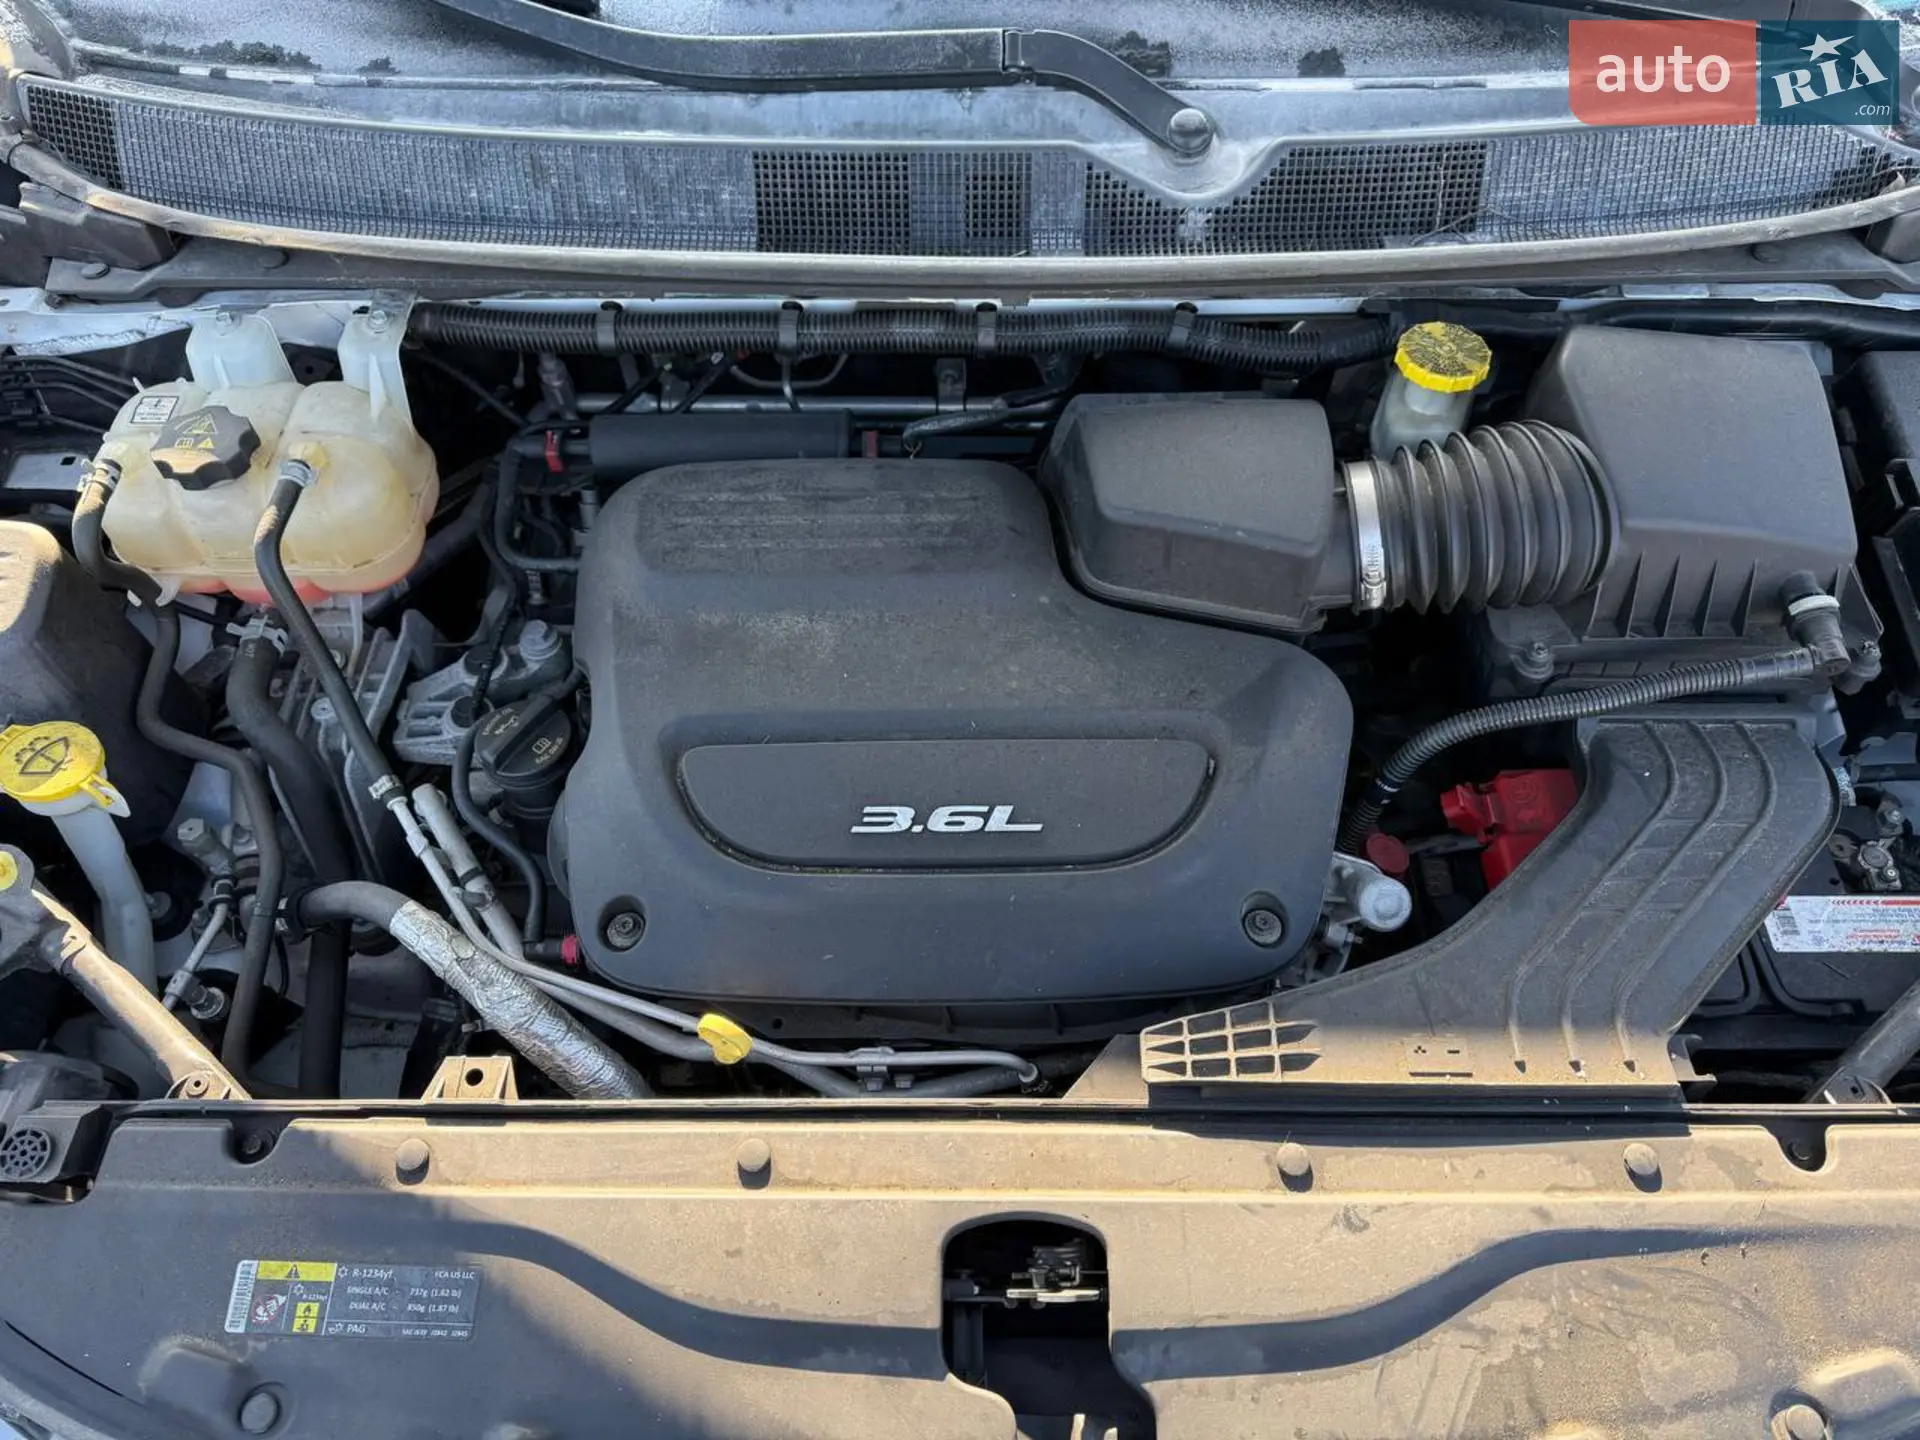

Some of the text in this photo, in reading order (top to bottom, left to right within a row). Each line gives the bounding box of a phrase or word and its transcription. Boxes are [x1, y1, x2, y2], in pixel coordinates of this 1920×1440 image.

[850, 804, 1044, 833] 3.6L
[352, 1267, 393, 1280] R-1234yf
[462, 1271, 475, 1280] LLC
[347, 1324, 366, 1333] PAG
